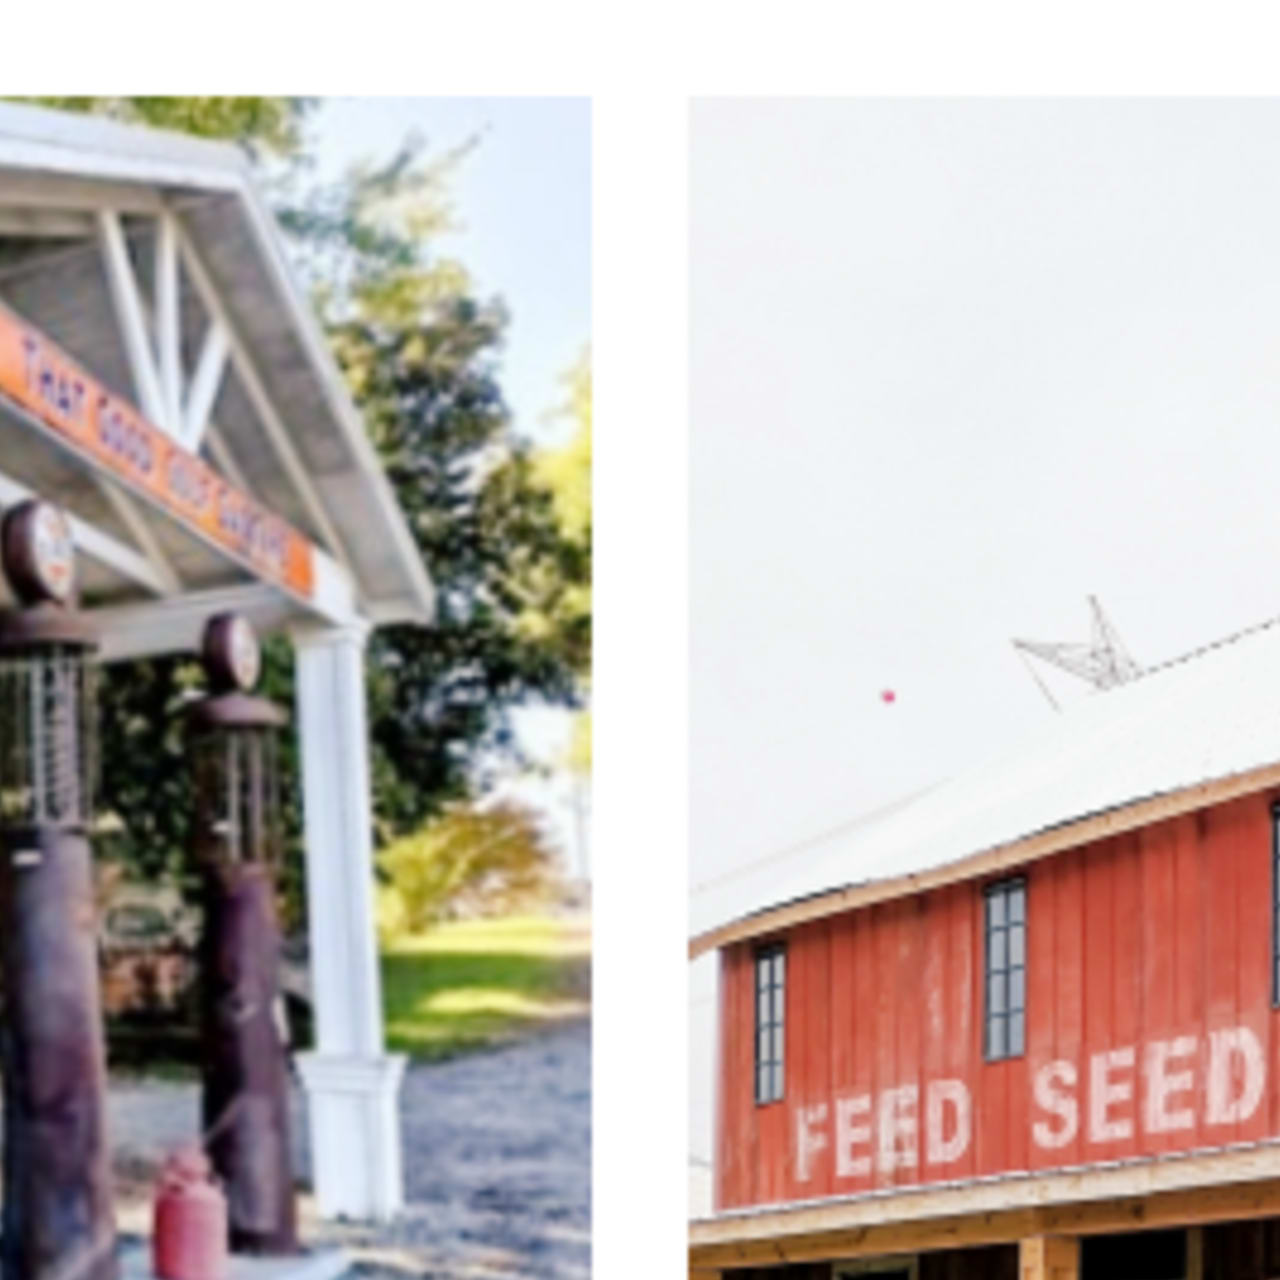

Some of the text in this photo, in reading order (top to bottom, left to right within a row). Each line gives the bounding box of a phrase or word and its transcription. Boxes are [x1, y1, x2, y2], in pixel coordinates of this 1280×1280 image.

[22, 336, 86, 416] THAT
[794, 1078, 972, 1183] FEED
[1031, 1025, 1268, 1150] SEED
